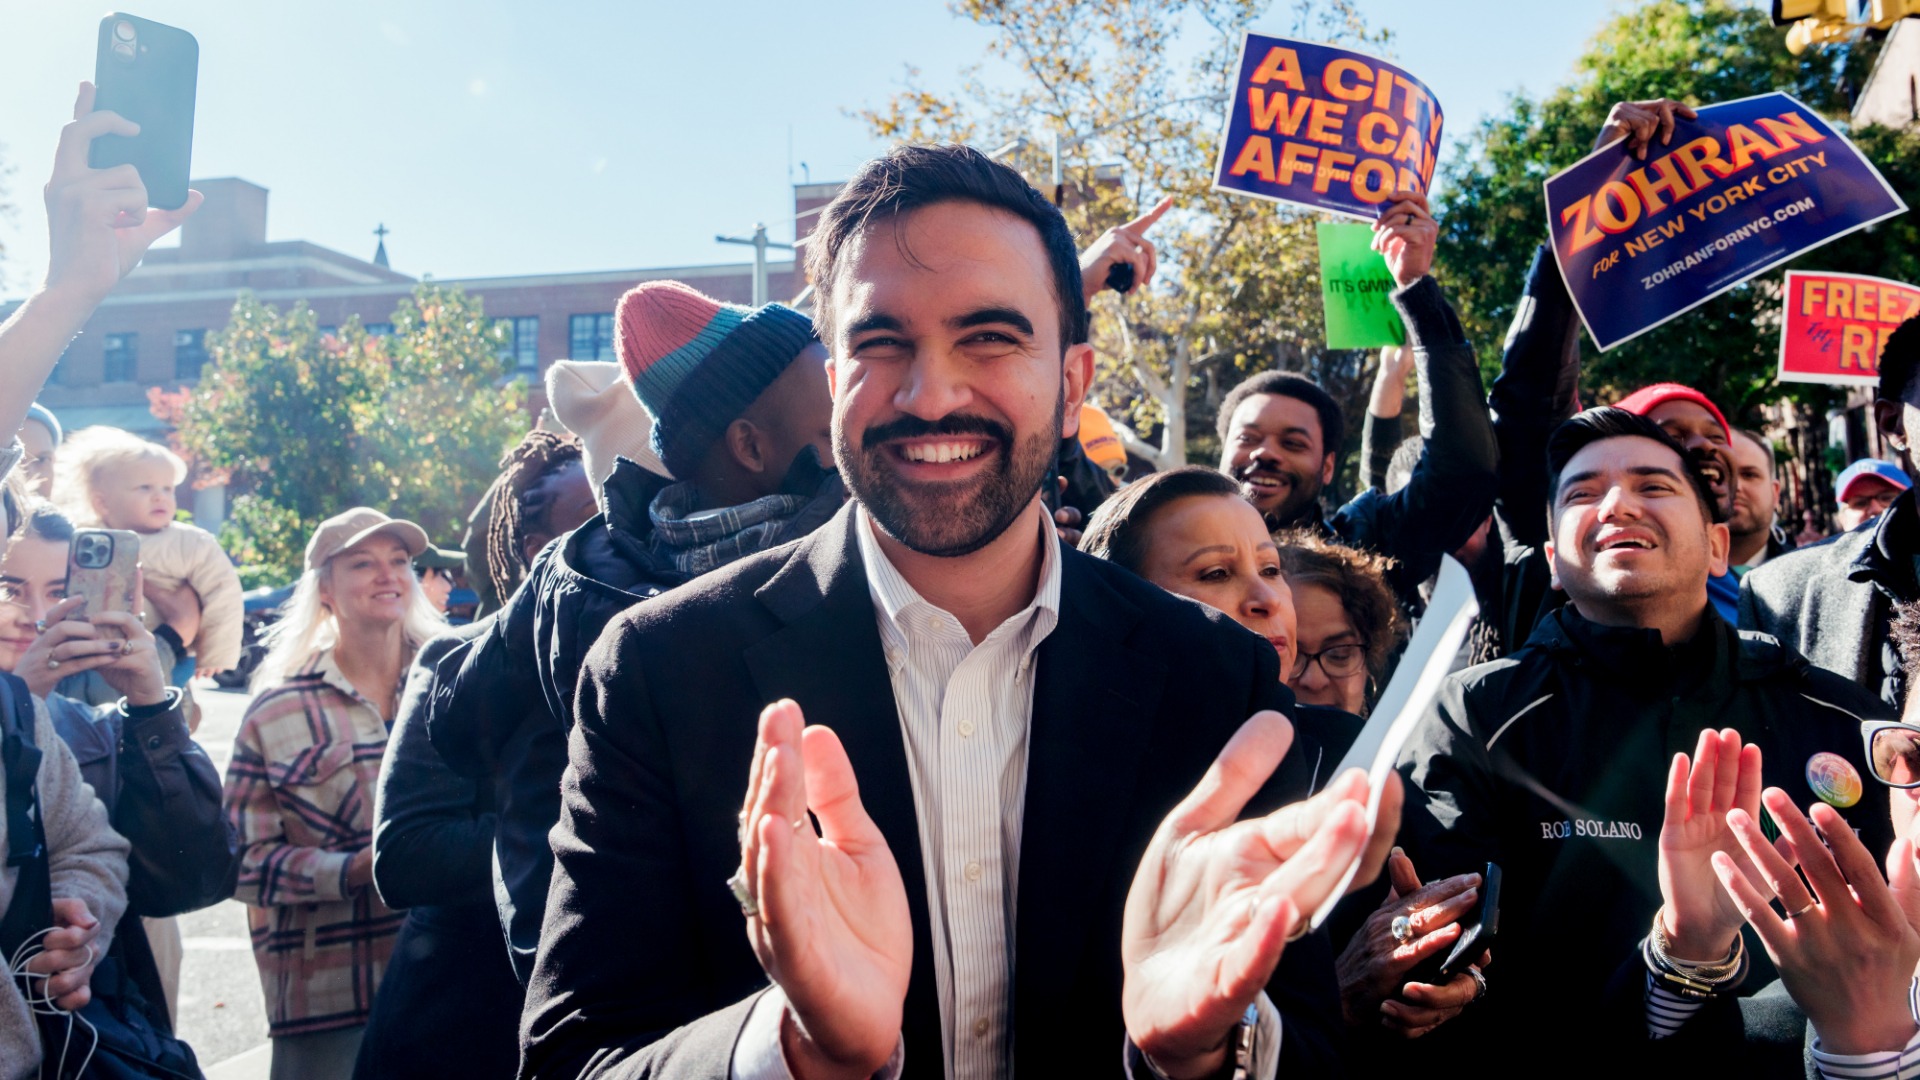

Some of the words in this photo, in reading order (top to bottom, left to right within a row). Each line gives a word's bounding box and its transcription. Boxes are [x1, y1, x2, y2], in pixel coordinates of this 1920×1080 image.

[1248, 87, 1348, 145] WE
[1250, 46, 1305, 91] A
[1322, 58, 1443, 146] CITY
[1561, 111, 1827, 256] ZOHRAN
[1592, 250, 1620, 279] FOR
[1624, 215, 1685, 258] NEW
[1687, 175, 1766, 222] YORK
[1767, 151, 1827, 184] CITY
[1641, 197, 1815, 290] ZOHRANFORNYC.COM
[1807, 322, 1834, 352] THE
[1540, 821, 1571, 839] ROB
[1575, 819, 1642, 840] SOLANO
